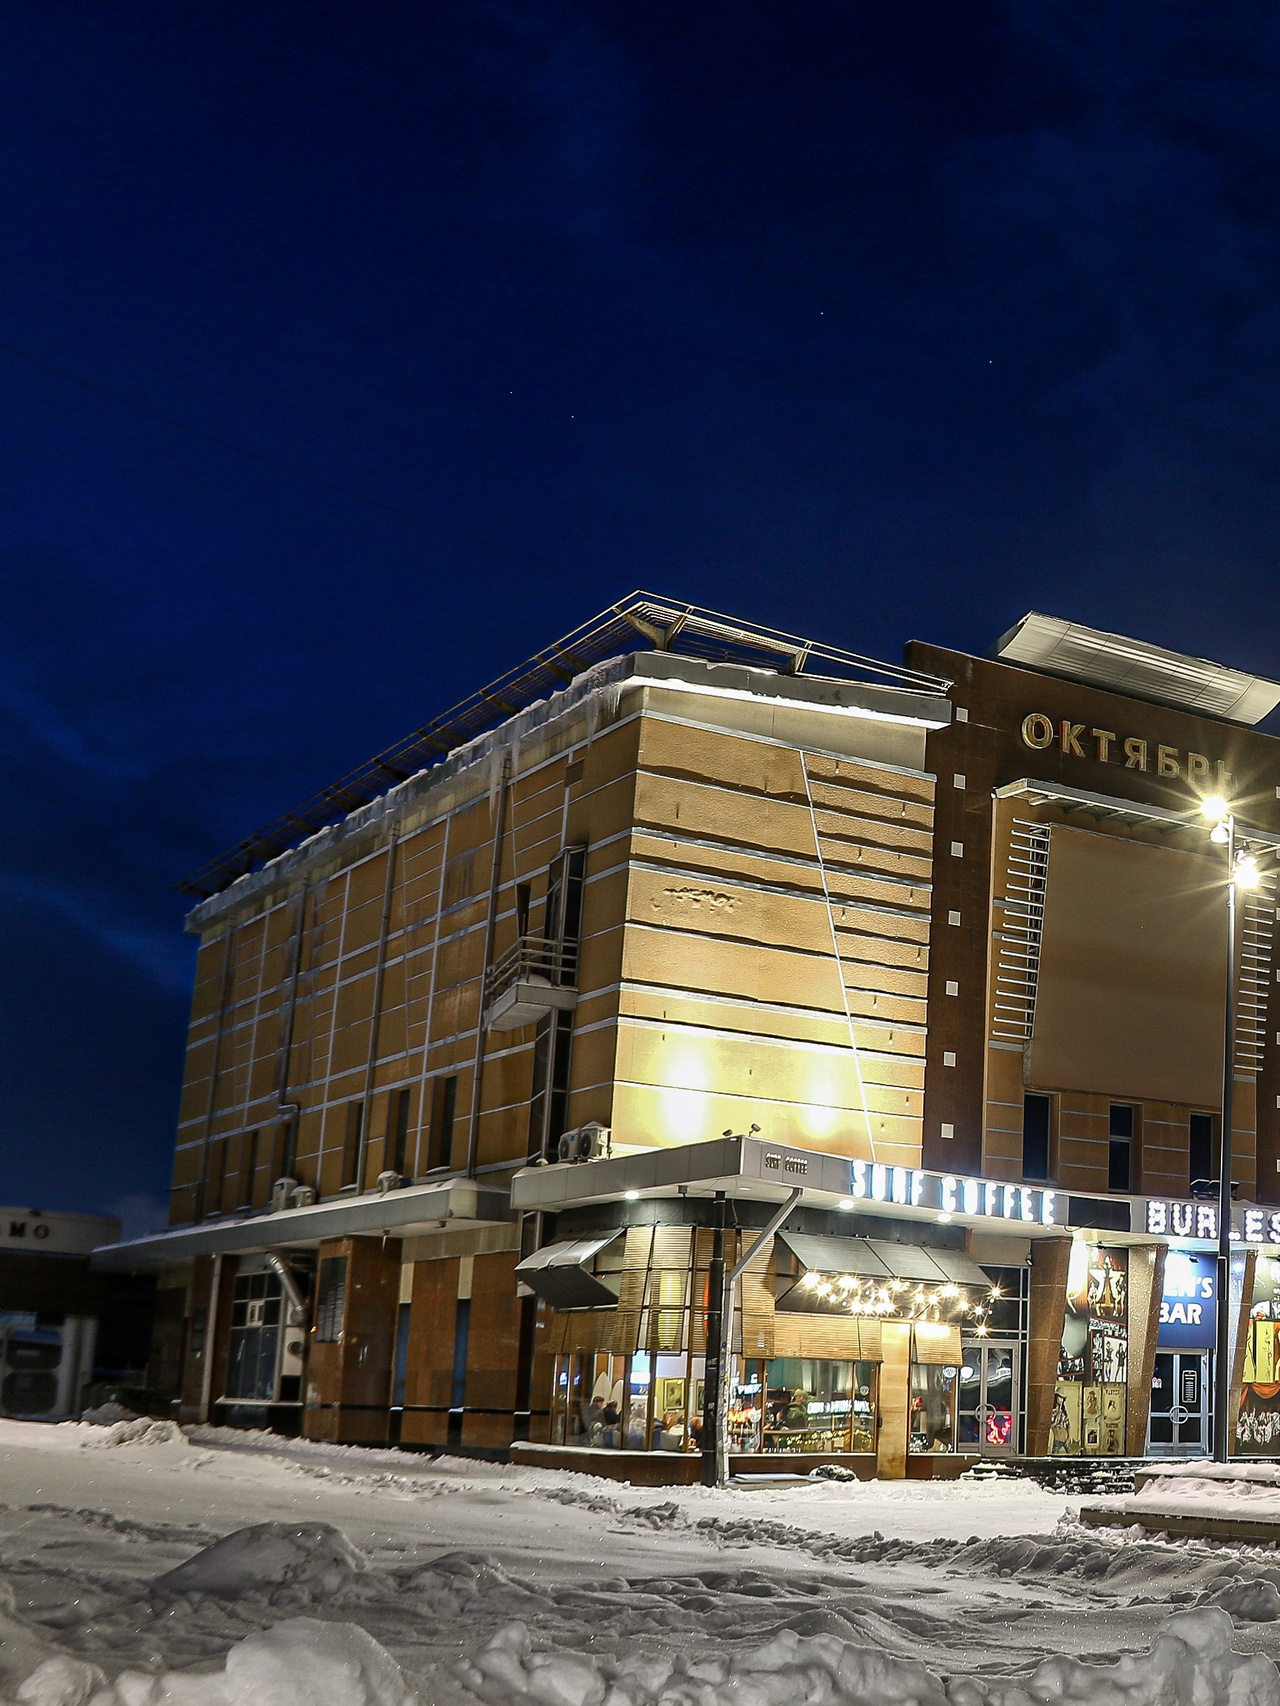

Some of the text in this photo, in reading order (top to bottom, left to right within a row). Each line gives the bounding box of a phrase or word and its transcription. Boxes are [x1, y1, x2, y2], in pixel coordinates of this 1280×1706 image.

[1021, 712, 1234, 786] ОКТЯБРЬ
[851, 1159, 1055, 1225] SURF COFFEE
[1159, 1302, 1203, 1325] BAR
